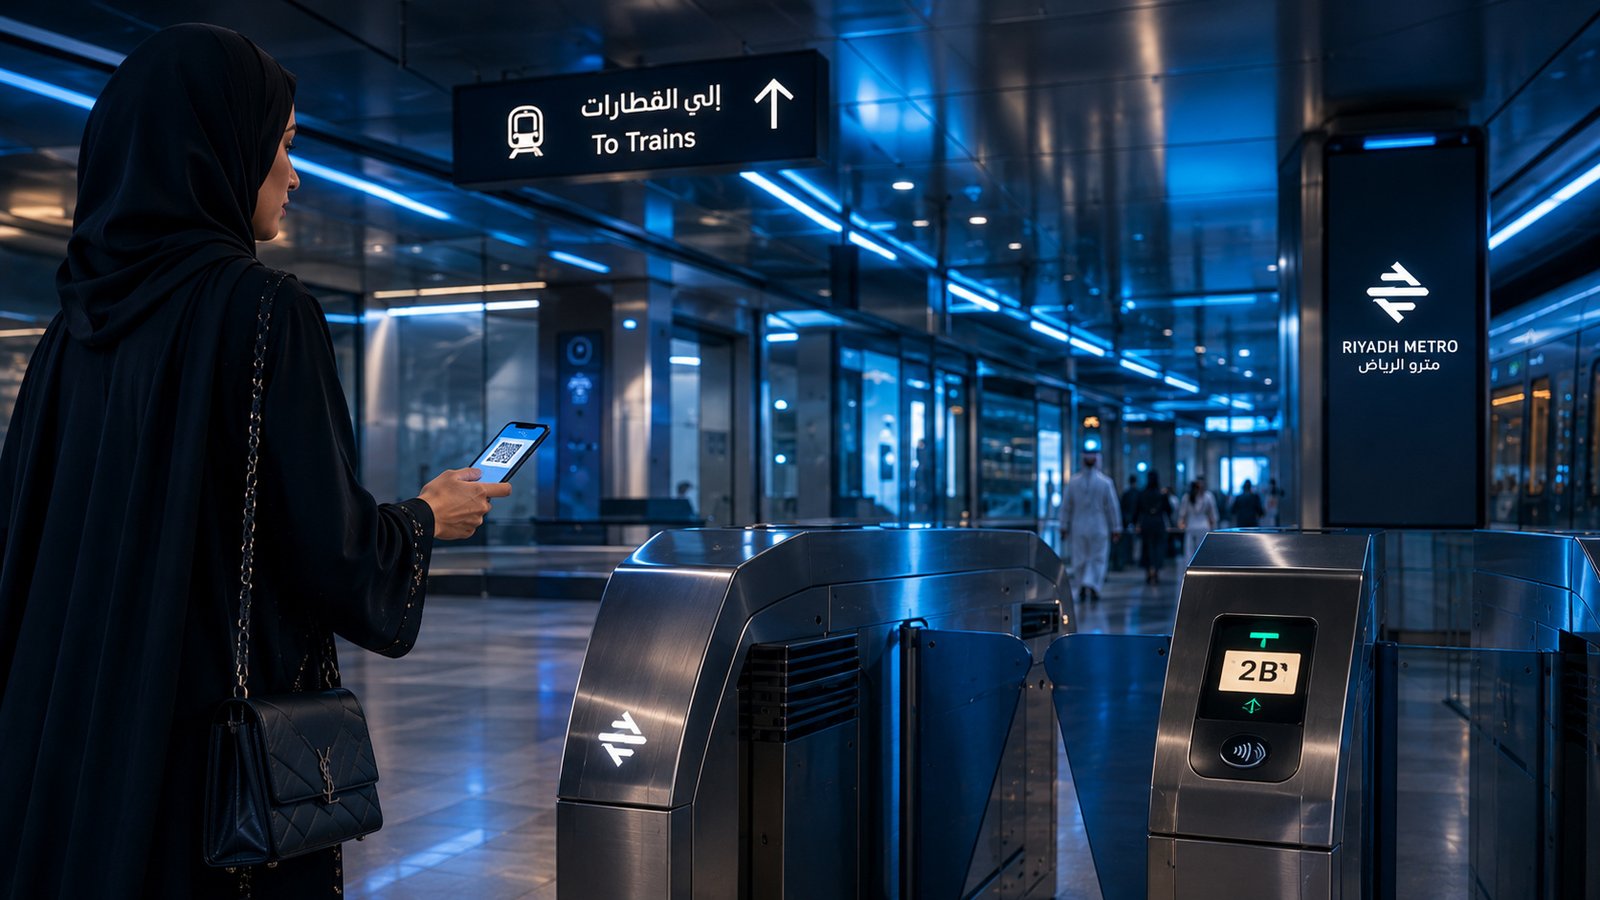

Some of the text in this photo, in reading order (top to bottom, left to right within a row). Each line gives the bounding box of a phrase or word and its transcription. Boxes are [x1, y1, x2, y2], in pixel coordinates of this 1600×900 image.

[581, 87, 678, 121] القطارات
[591, 127, 696, 155] To Trains
[1342, 339, 1459, 354] RIYADH METRO
[1358, 358, 1440, 374] مترو الرياض
